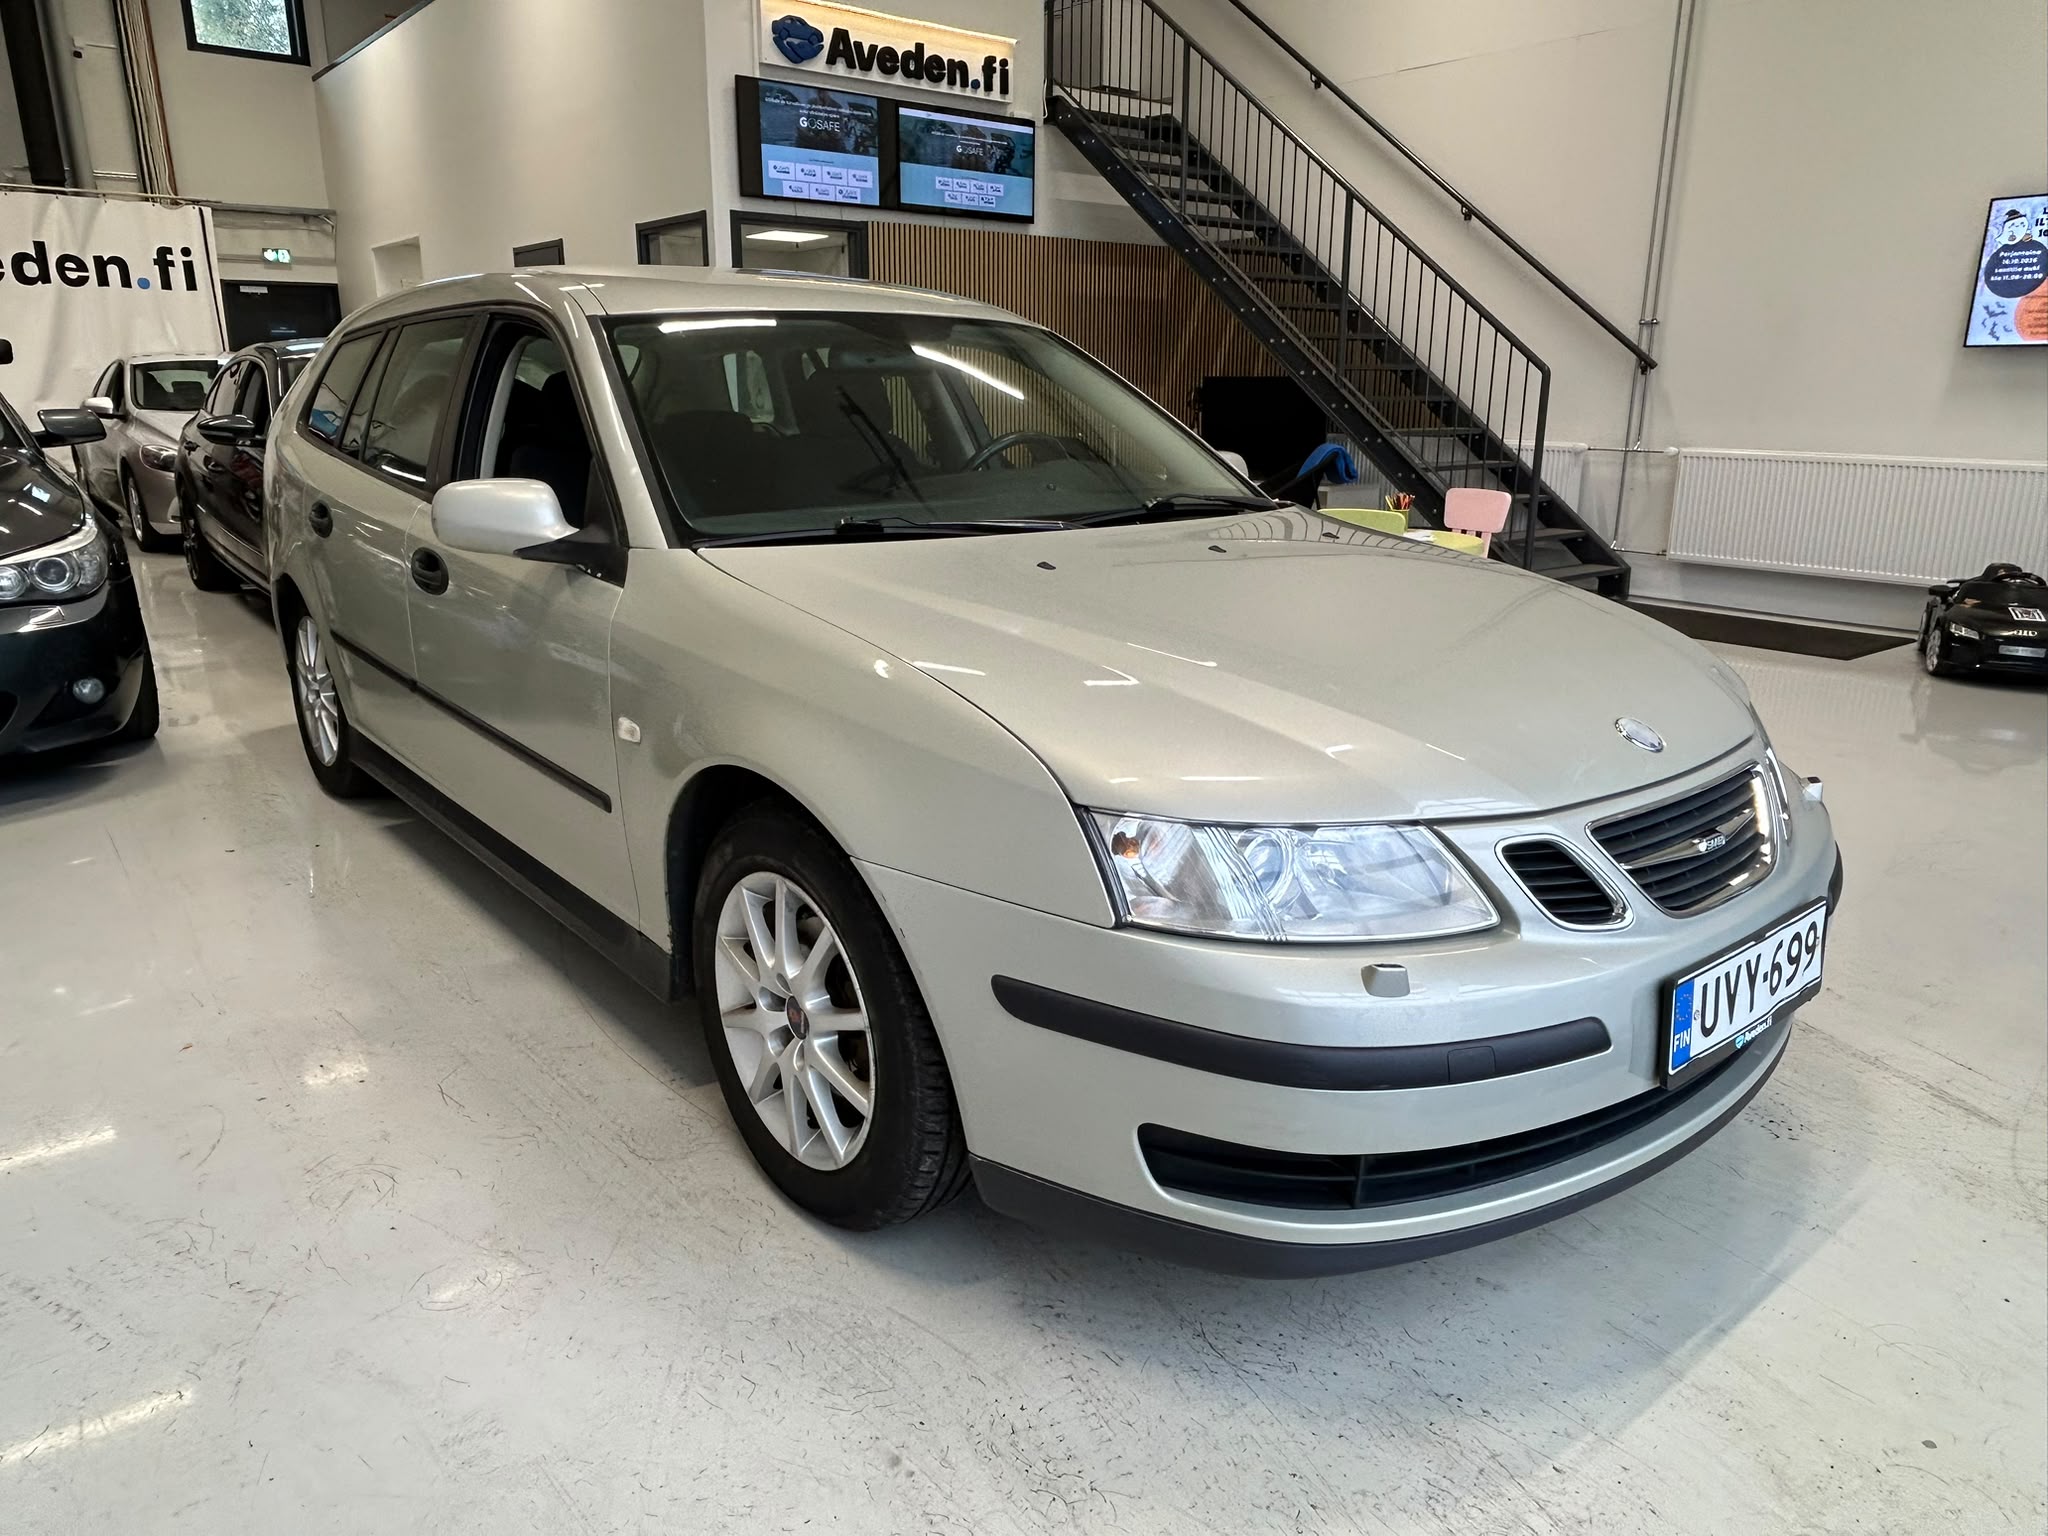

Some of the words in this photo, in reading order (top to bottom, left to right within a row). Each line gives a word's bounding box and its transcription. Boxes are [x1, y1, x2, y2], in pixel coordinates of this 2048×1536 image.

[826, 27, 1009, 95] Aveden.fi
[799, 117, 841, 132] GOSAFE
[0, 240, 198, 291] den.fi
[1701, 921, 1818, 1038] UVY-699
[1673, 1028, 1691, 1053] FIN
